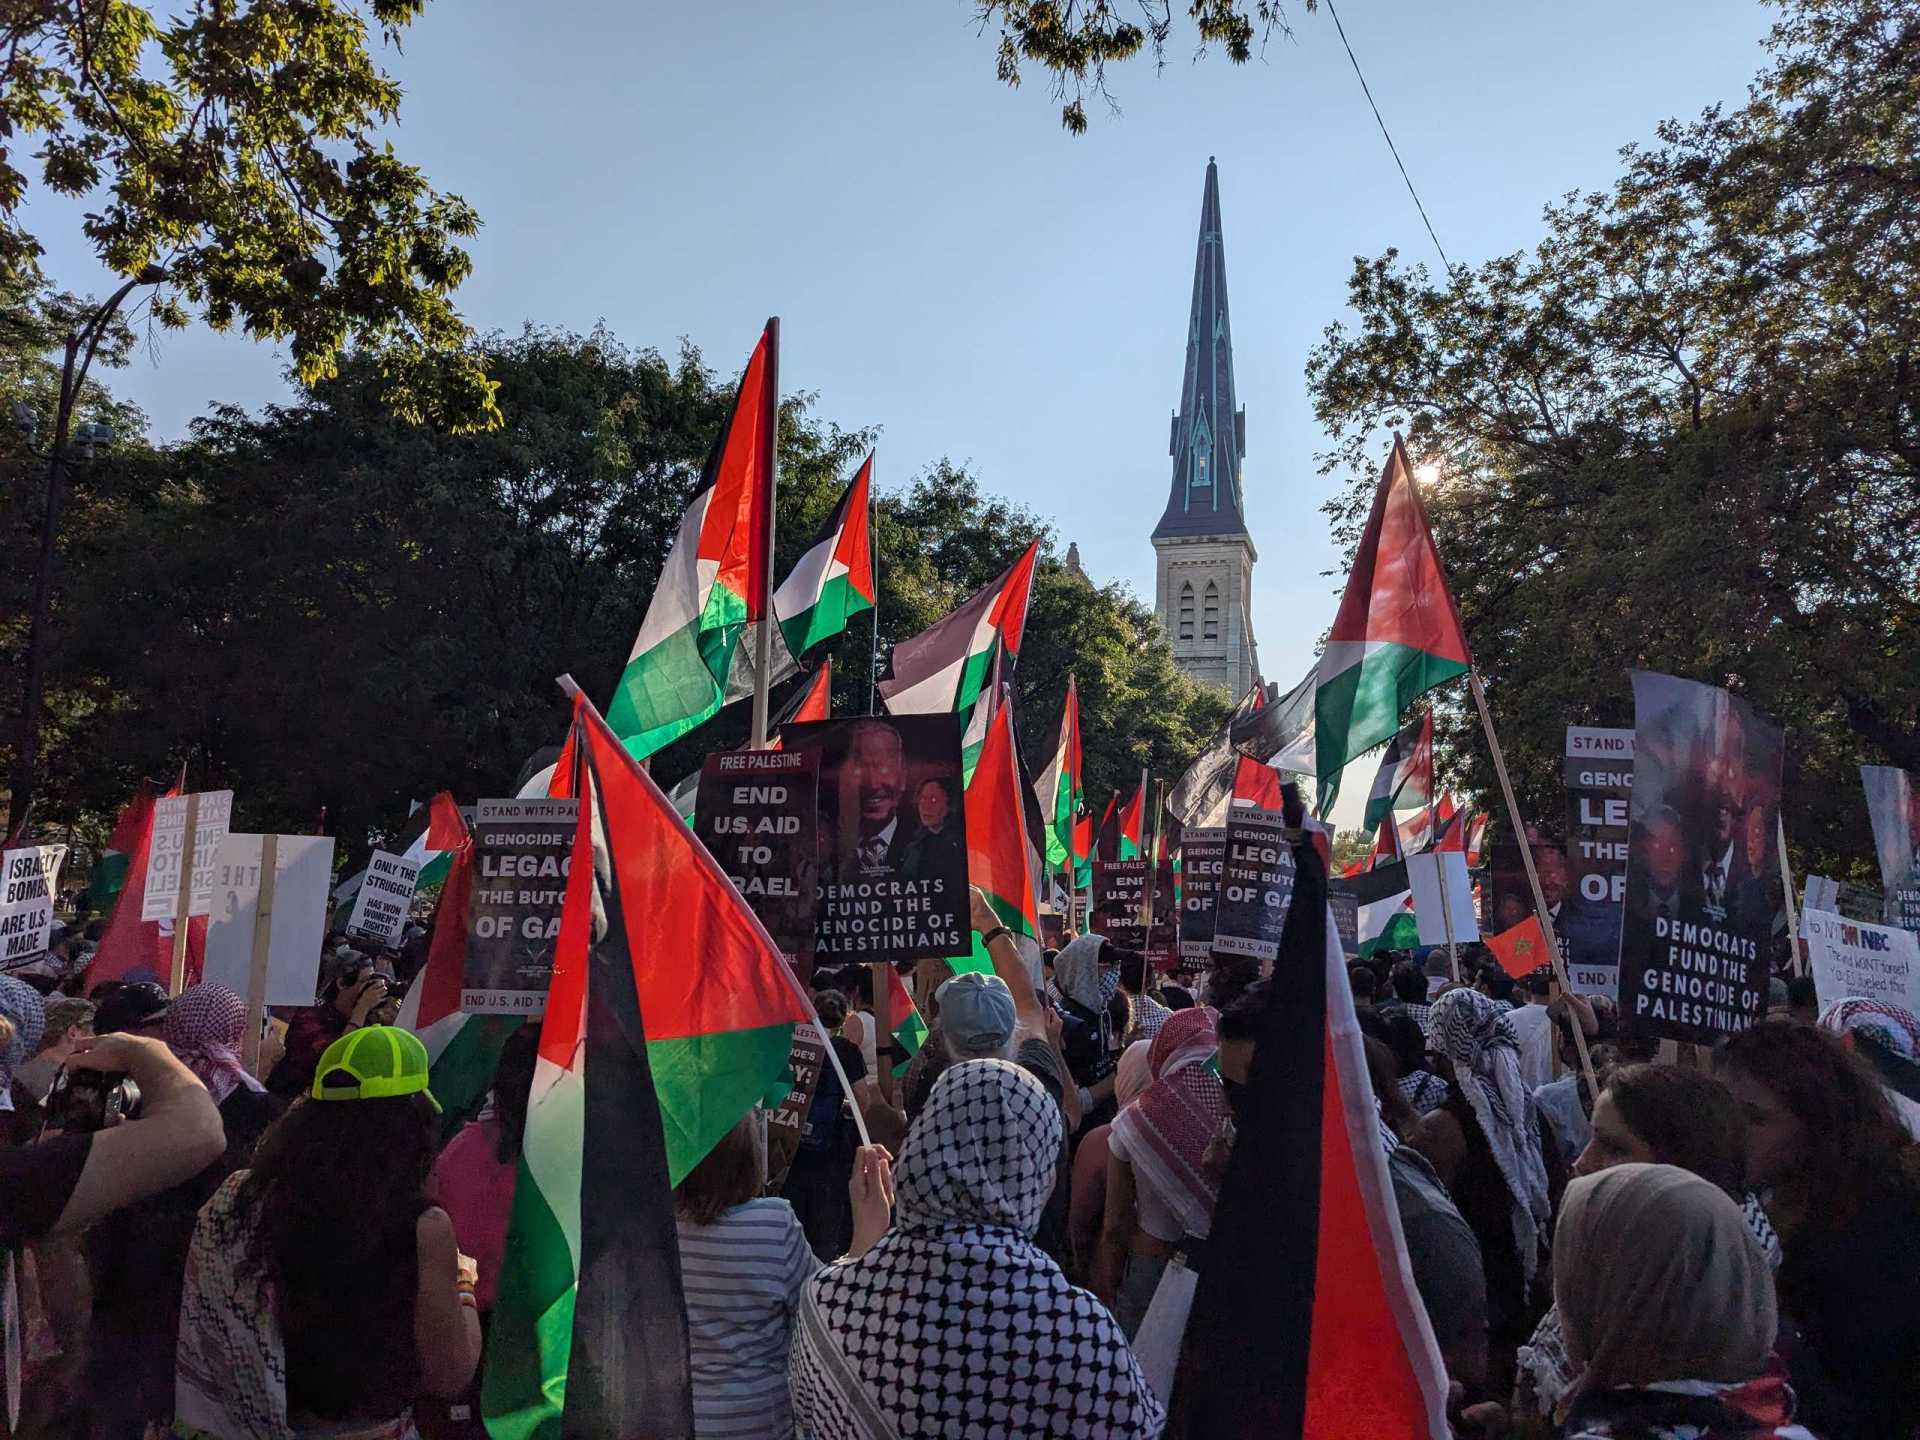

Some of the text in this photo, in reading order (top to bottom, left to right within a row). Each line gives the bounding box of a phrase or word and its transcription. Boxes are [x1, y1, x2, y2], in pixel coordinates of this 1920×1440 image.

[1573, 736, 1625, 751] STAND
[720, 753, 802, 769] FREE PALESTINE
[733, 786, 788, 804] END
[483, 806, 521, 817] STAND
[525, 806, 554, 817] WITH
[1233, 811, 1262, 820] STAND
[1580, 798, 1628, 826] LE
[714, 816, 801, 834] U.S. AID
[484, 834, 563, 846] GENOCIDE
[738, 846, 772, 864] TO
[1579, 842, 1629, 860] THE
[9, 854, 58, 880] ISRAELI
[374, 860, 417, 882] ONLY THE
[1230, 868, 1258, 880] THE
[6, 877, 51, 904] BOMBS
[366, 875, 413, 898] STRUGGLE
[1106, 890, 1161, 900] U.S. AD
[1187, 882, 1212, 891] THE
[1227, 886, 1258, 903] OF
[367, 898, 382, 909] HAS
[479, 891, 514, 904] THE
[827, 897, 931, 916] FUND THE
[1187, 897, 1213, 911] OF
[0, 909, 48, 936] ARE U.S.
[363, 908, 399, 926] WOMEN'S
[928, 914, 954, 928] OF
[363, 919, 393, 935] RIGHTS!
[475, 916, 514, 938] OF
[6, 931, 40, 957] MADE
[1218, 938, 1274, 954] END U.S. AID
[1656, 916, 1756, 960] DEMOCRATS
[1860, 929, 1890, 952] NBC
[1668, 945, 1747, 983] FUND THE
[1577, 972, 1607, 985] END
[1643, 968, 1735, 1006] GENOCIDE
[1741, 990, 1759, 1011] OF
[465, 995, 485, 1006] END
[488, 996, 510, 1007] U.S.
[513, 996, 533, 1007] AID
[788, 1063, 812, 1085] Y:
